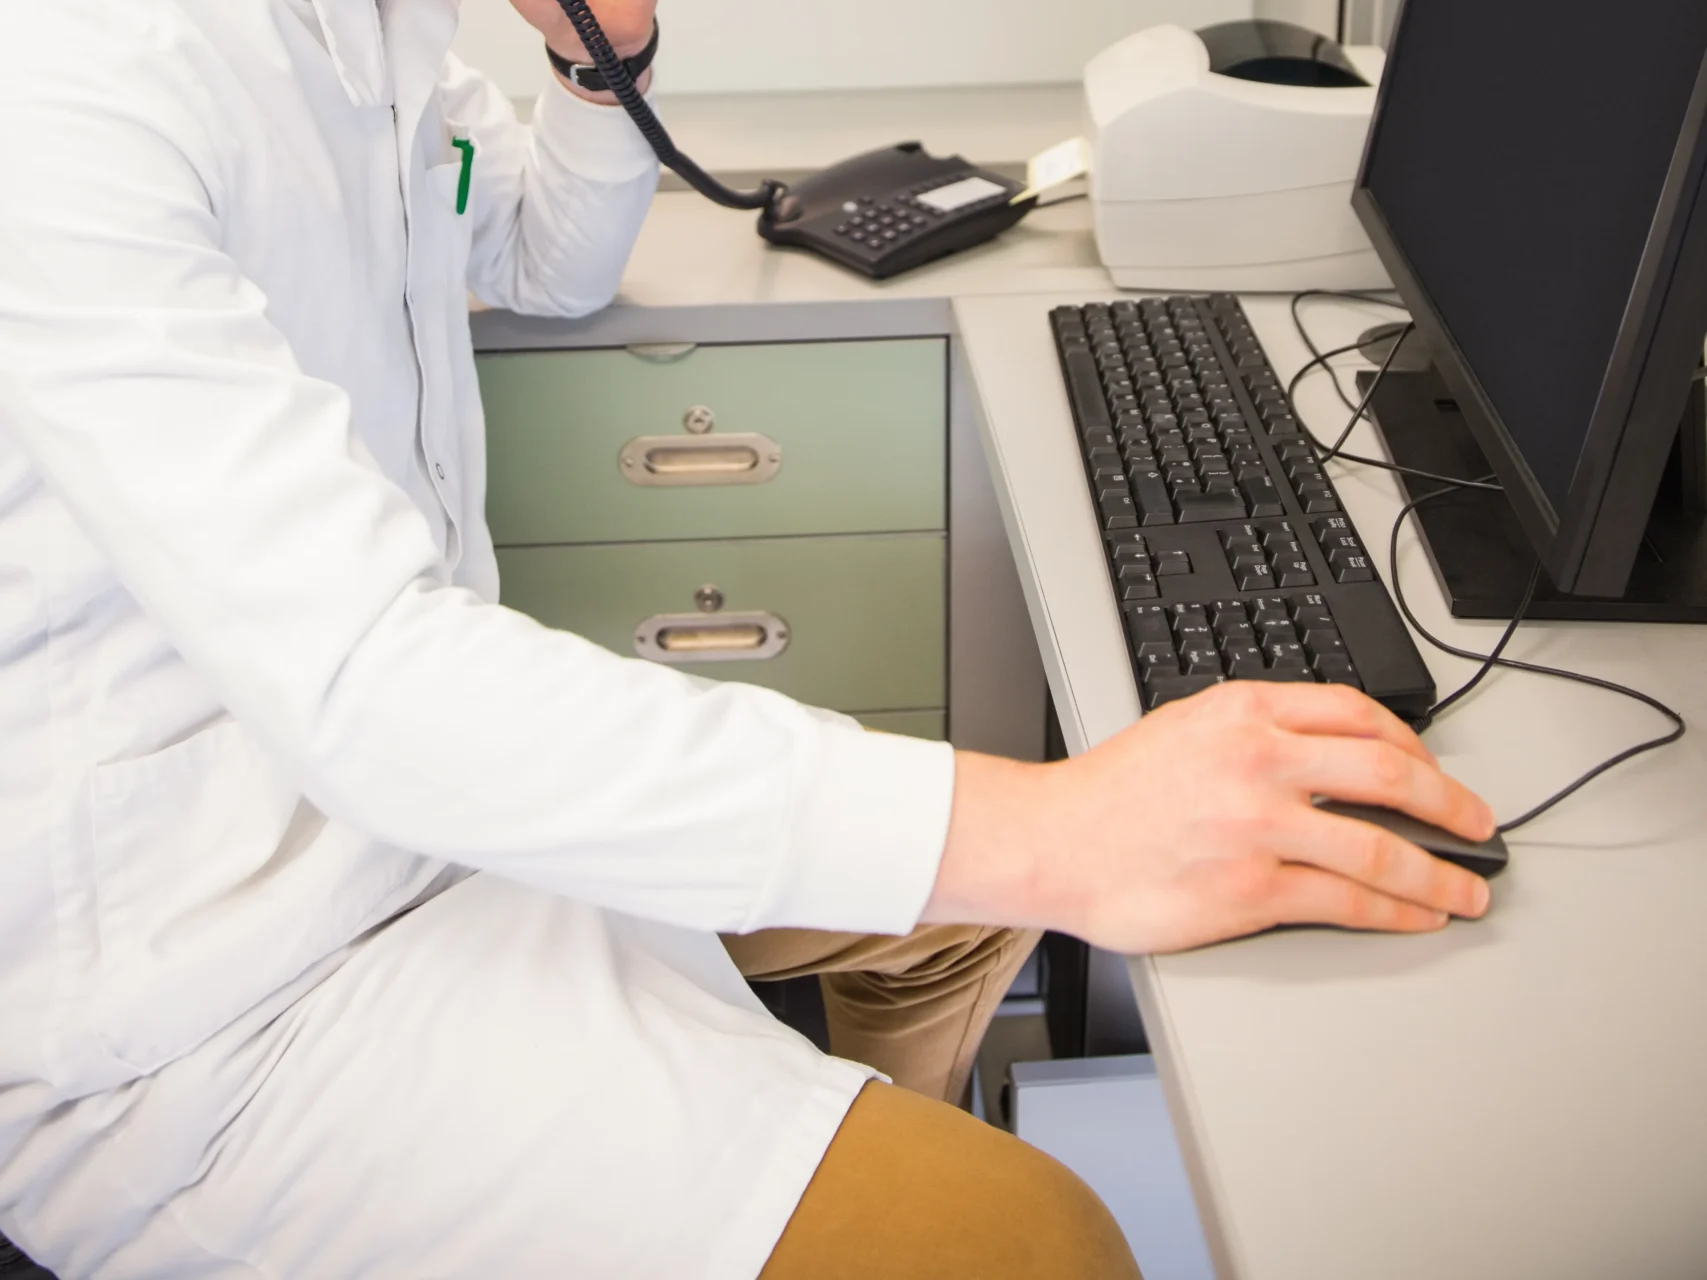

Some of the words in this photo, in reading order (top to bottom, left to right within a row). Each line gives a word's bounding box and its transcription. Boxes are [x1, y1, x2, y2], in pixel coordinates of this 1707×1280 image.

[1254, 565, 1262, 575] Down
[1306, 595, 1315, 604] Lock
[1148, 654, 1157, 663] Del
